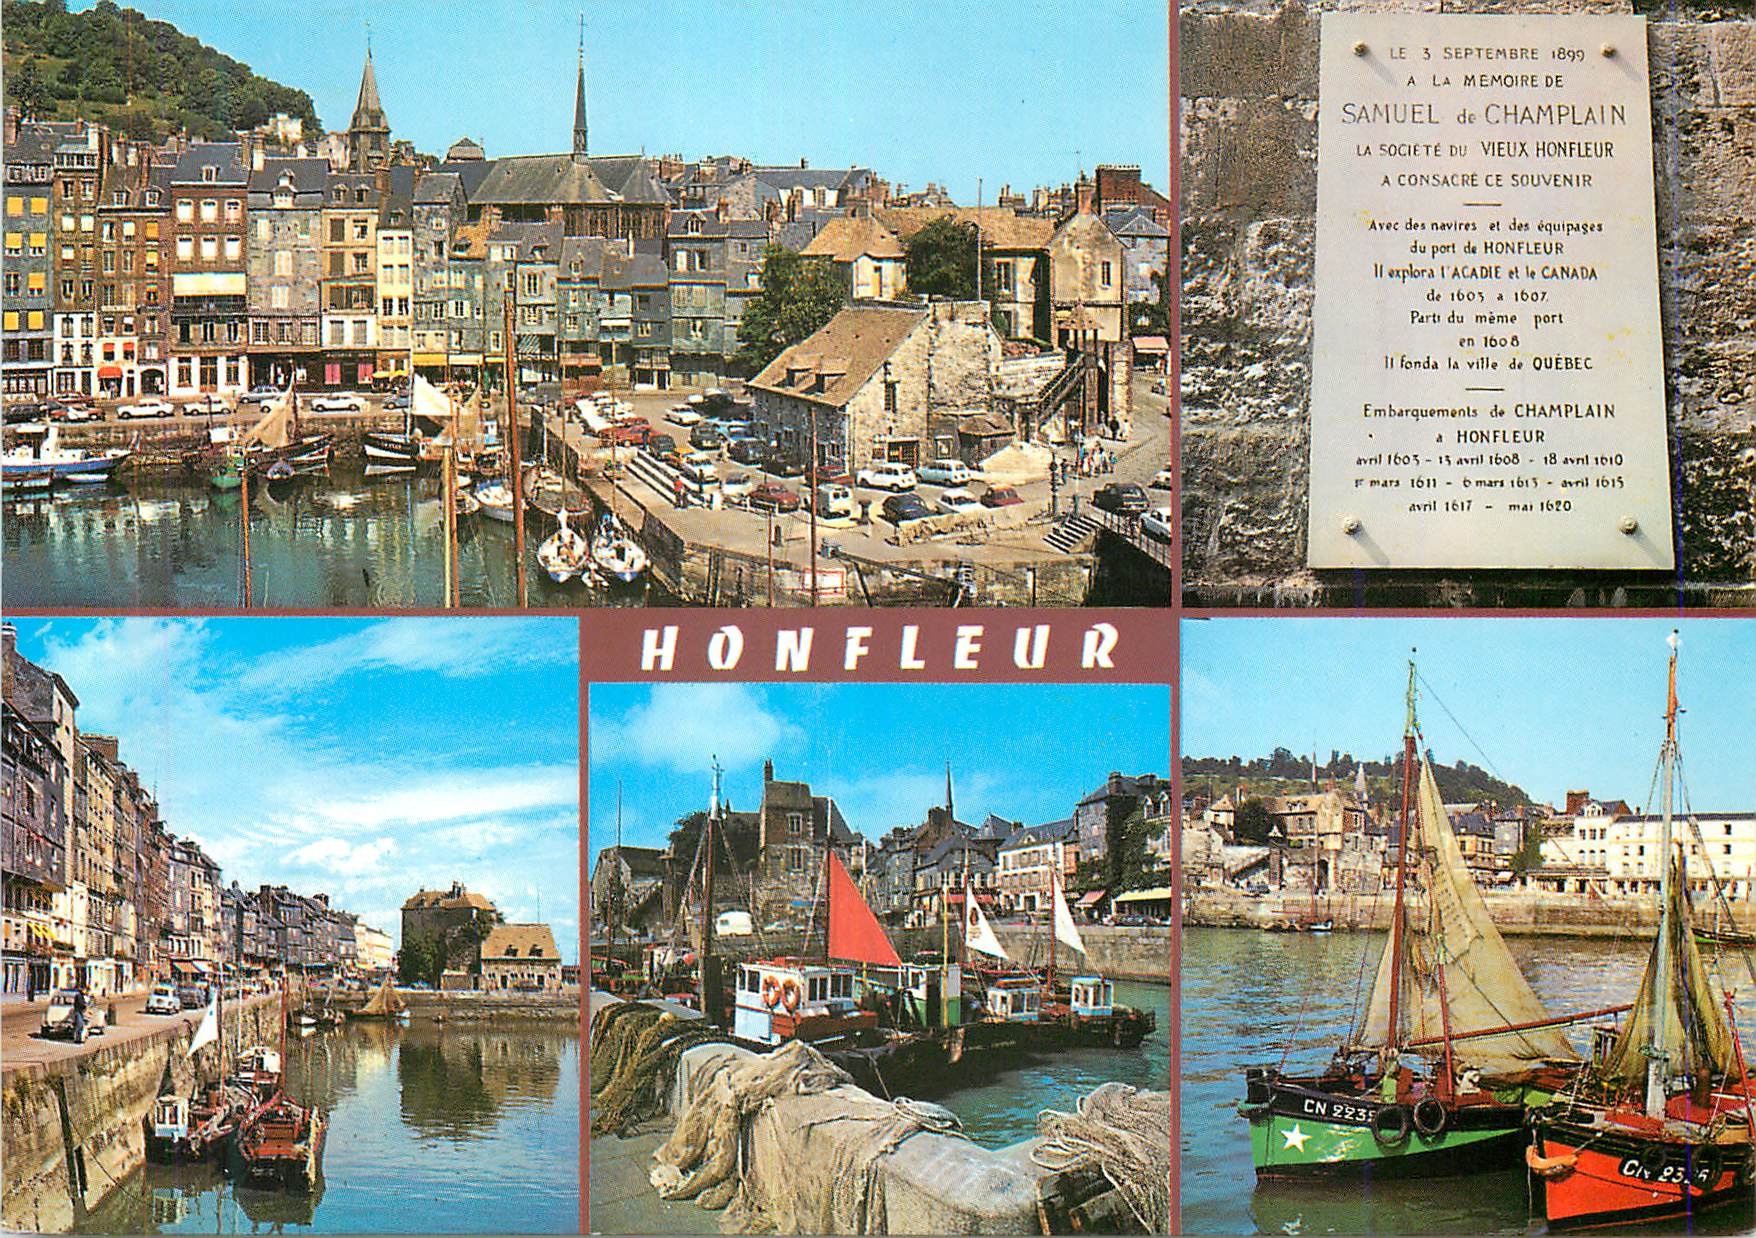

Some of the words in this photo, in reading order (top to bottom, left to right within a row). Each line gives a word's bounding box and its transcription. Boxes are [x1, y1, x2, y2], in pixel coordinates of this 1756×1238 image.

[1389, 46, 1407, 60] LE
[1423, 47, 1431, 61] 3
[1443, 46, 1539, 61] SEPTEMBRE
[1551, 46, 1585, 63] 1899
[1432, 73, 1451, 88] LA
[1544, 74, 1564, 89] DE
[1341, 102, 1441, 125] SAMUEL
[1456, 107, 1477, 125] de
[1484, 103, 1626, 127] CHAMPLAIN
[1356, 144, 1372, 157] LA
[1449, 144, 1468, 158] DU
[1480, 140, 1529, 159] VIEUX
[1535, 140, 1614, 159] HONFLEUR
[1380, 174, 1391, 187] A
[1484, 173, 1504, 188] CE
[1510, 173, 1593, 188] SOUVENIR
[1367, 219, 1399, 232] Avec
[1404, 216, 1427, 232] des
[1430, 219, 1478, 232] navires
[1488, 220, 1501, 232] et
[1508, 216, 1530, 232] des
[1537, 219, 1603, 237] équipages
[1409, 239, 1427, 254] du
[1431, 242, 1456, 259] port
[1463, 239, 1478, 255] de
[1483, 240, 1564, 256] HONFLEUR
[1373, 262, 1384, 279] Il
[1387, 262, 1435, 285] explora
[1507, 265, 1520, 280] et
[1525, 264, 1537, 281] le
[1540, 265, 1598, 281] CANADA
[1426, 288, 1442, 303] de
[1410, 309, 1441, 325] Parti
[1447, 309, 1465, 324] du
[1533, 312, 1564, 330] port
[1458, 337, 1475, 348] en
[1483, 334, 1520, 349] 1608
[1384, 354, 1394, 370] Il
[1399, 353, 1439, 371] fonda
[1447, 356, 1460, 371] la
[1466, 356, 1499, 371] ville
[1508, 356, 1524, 371] de
[1532, 352, 1593, 372] QUÉBEC
[1363, 403, 1479, 422] Embarquements
[1489, 403, 1506, 419] de
[1514, 403, 1616, 419] CHAMPLAIN
[1456, 429, 1545, 444] HONFLEUR
[1355, 452, 1383, 467] avril
[1455, 453, 1484, 466] avril
[1488, 452, 1521, 466] 1608
[1543, 451, 1558, 466] 18
[1562, 452, 1590, 467] avril
[1593, 452, 1624, 467] 1610
[1369, 479, 1401, 489] mars
[1410, 474, 1437, 489] 1611
[1474, 479, 1505, 488] mars
[1560, 476, 1590, 489] avril
[1408, 499, 1437, 513] avril
[1444, 498, 1473, 513] 1617
[1508, 503, 1534, 513] mai
[1539, 499, 1572, 513] 1620
[1303, 1098, 1327, 1115] CN
